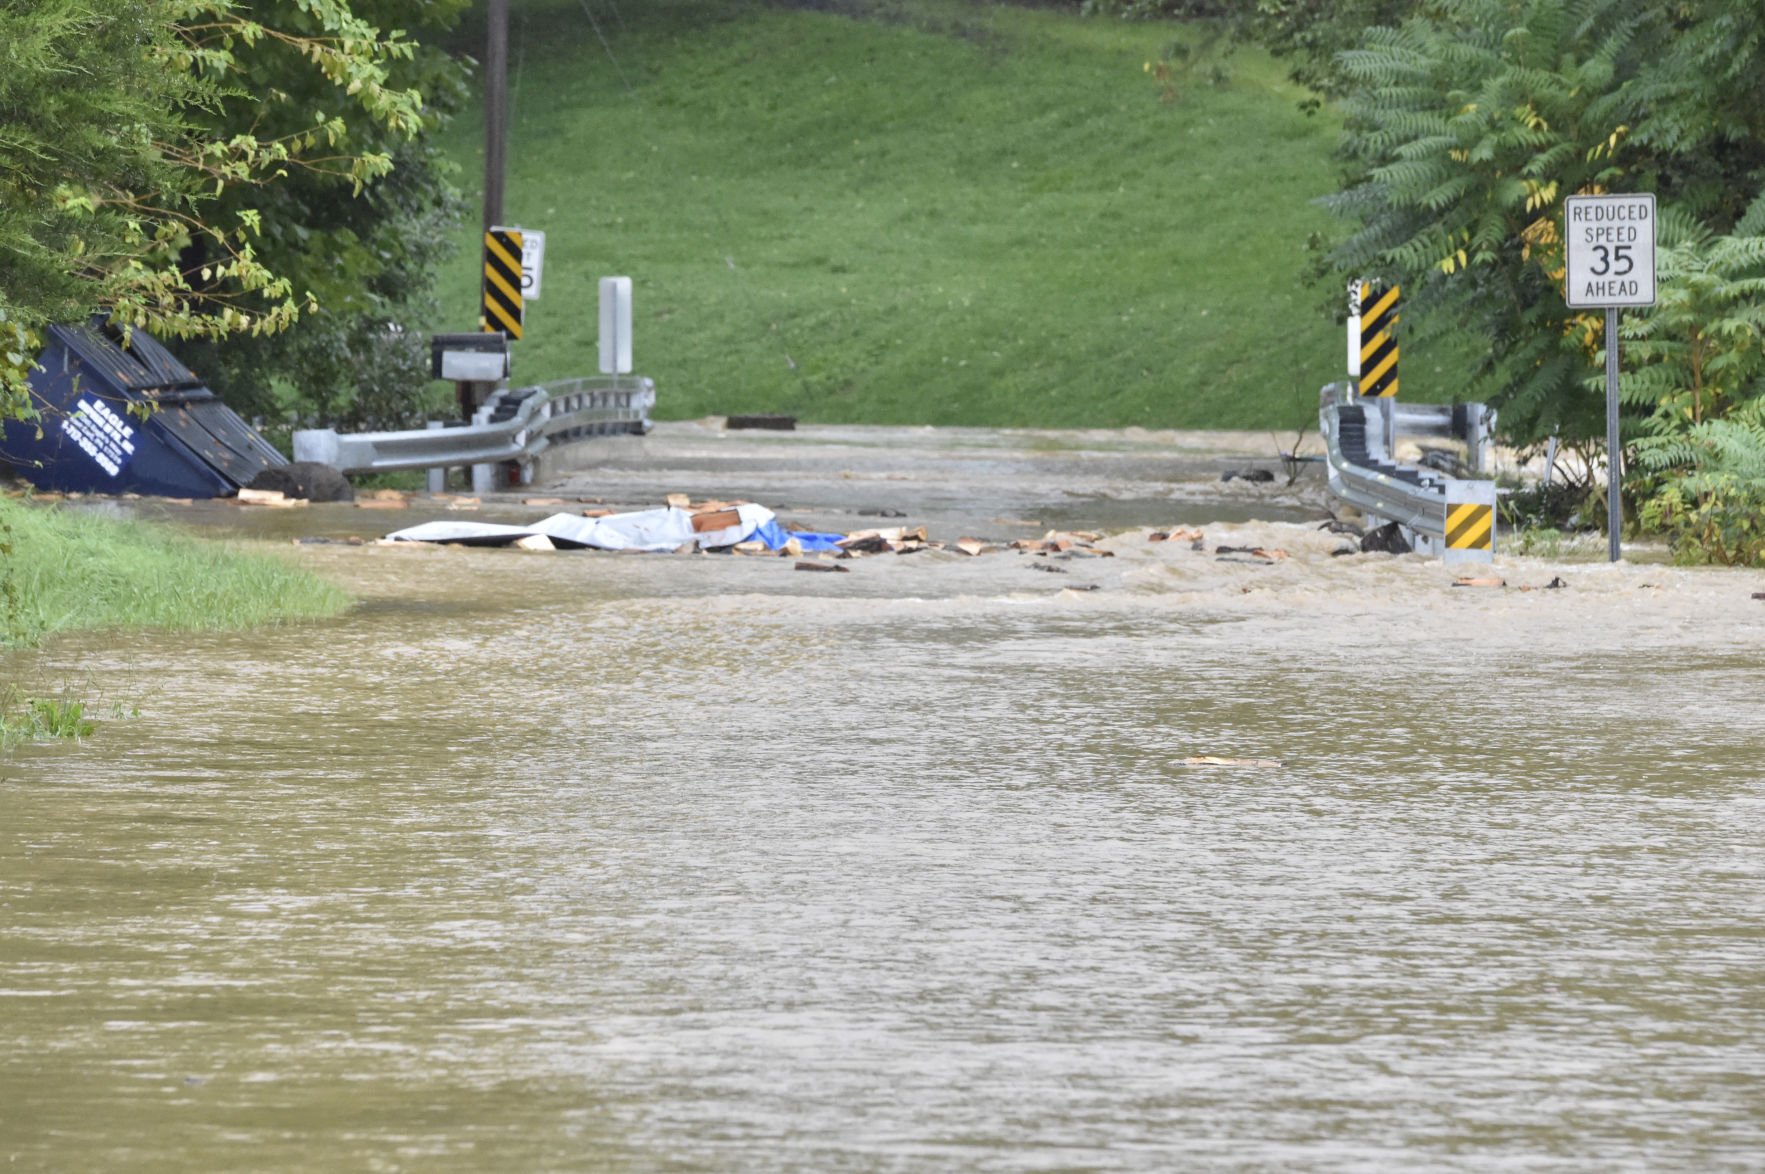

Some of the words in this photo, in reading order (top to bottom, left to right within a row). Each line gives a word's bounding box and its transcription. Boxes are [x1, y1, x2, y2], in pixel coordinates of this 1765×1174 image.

[1573, 204, 1648, 222] REDUCED
[1585, 226, 1637, 243] SPEED
[1590, 245, 1634, 276] 35
[1585, 280, 1639, 297] AHEAD
[93, 399, 134, 440] EAGLE
